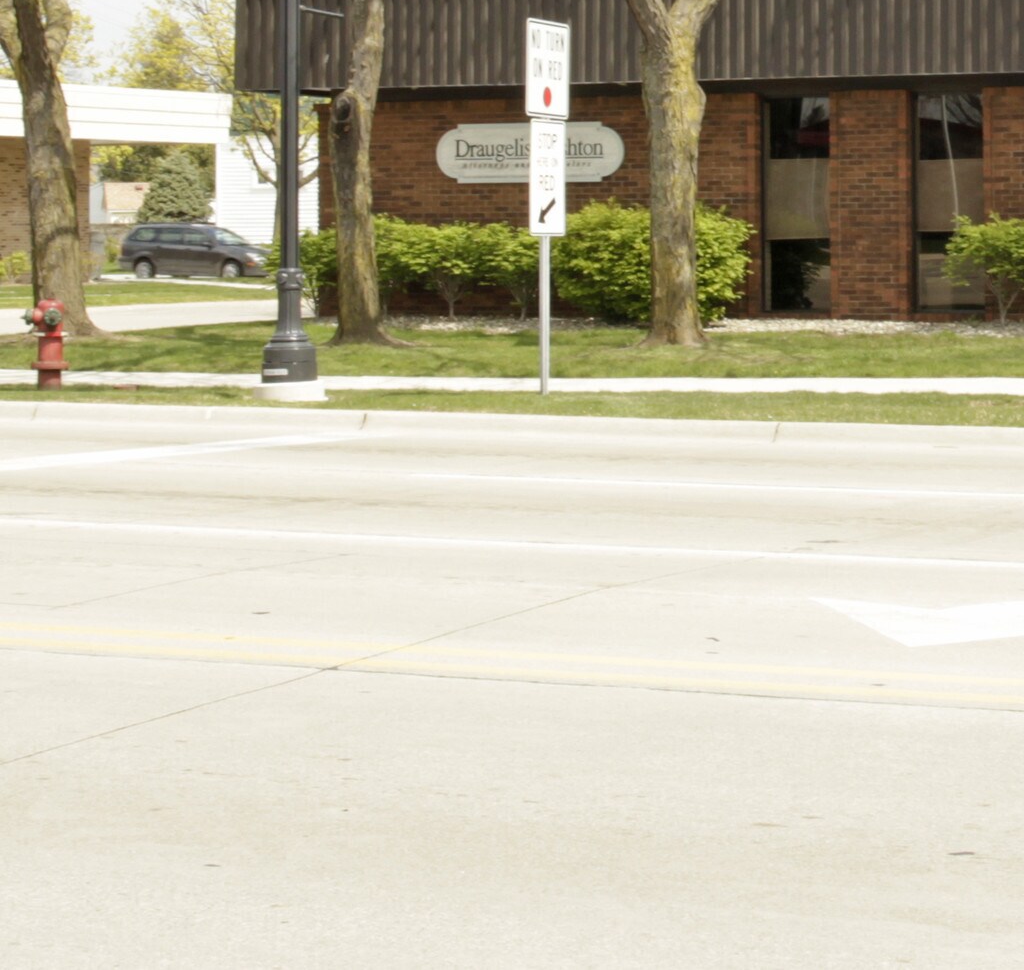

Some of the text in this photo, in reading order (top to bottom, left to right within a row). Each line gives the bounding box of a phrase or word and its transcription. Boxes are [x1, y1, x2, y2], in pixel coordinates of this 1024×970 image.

[531, 28, 565, 53] NO TURN
[533, 57, 562, 81] ON RED
[455, 139, 530, 162] Draugelis
[538, 132, 558, 150] STOP
[539, 174, 555, 191] RED
